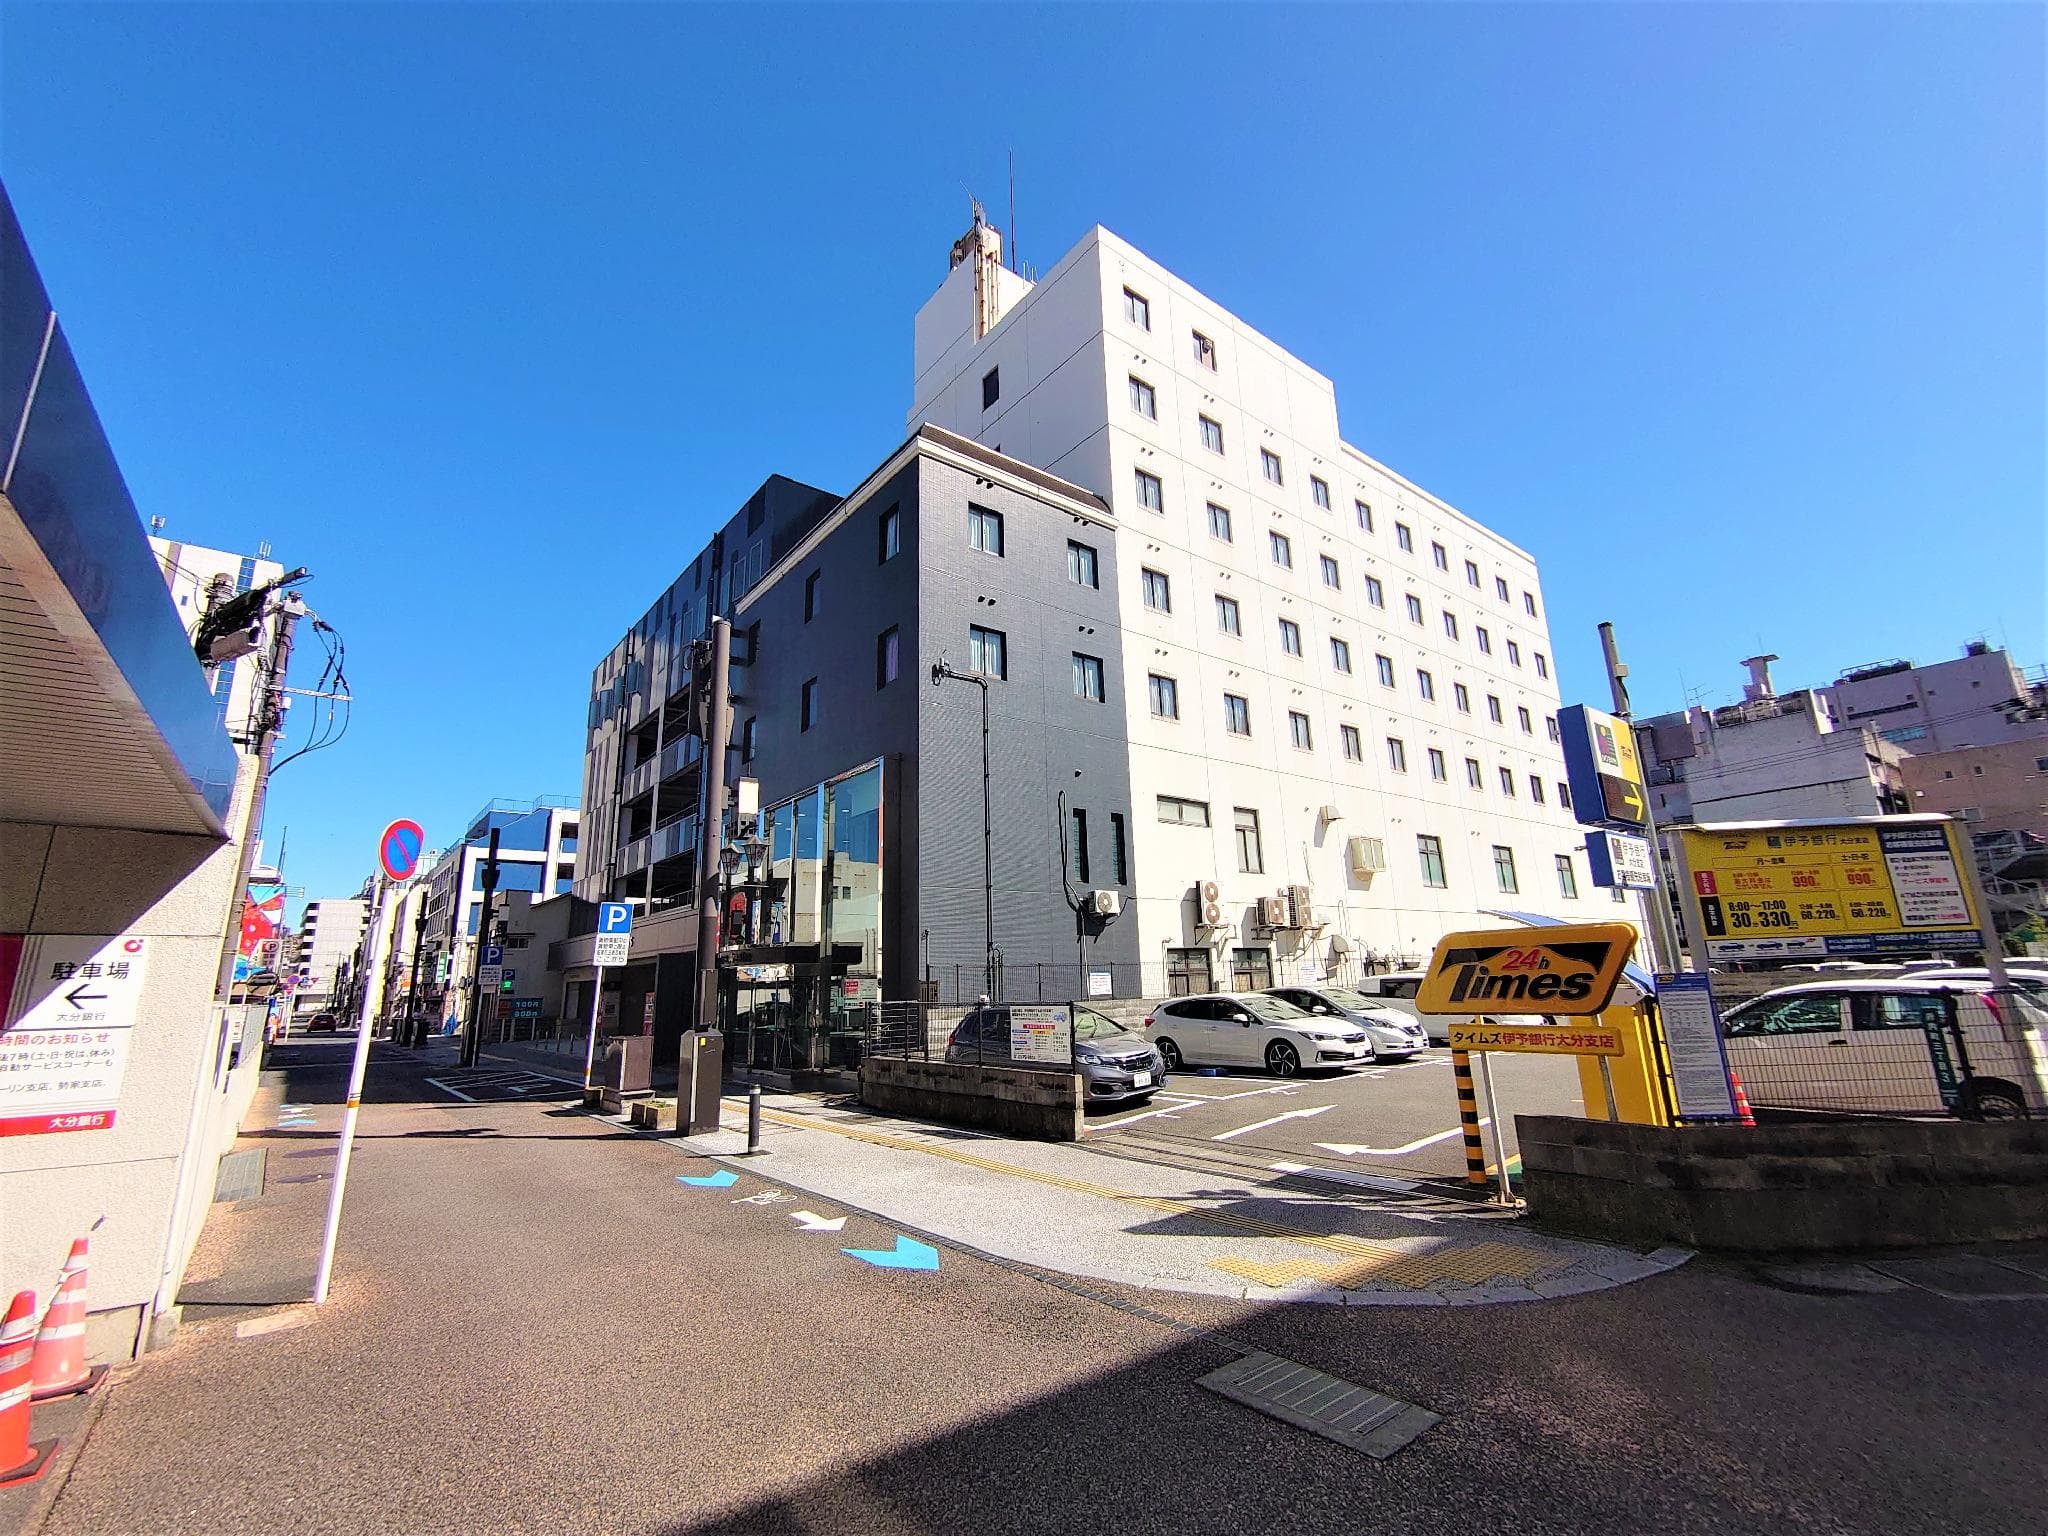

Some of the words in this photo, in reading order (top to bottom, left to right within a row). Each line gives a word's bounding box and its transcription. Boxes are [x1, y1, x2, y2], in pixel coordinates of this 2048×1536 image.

[607, 905, 627, 931] P
[487, 948, 500, 964] P
[50, 961, 130, 981] 駐車場
[1449, 964, 1596, 1003] Times
[56, 1012, 106, 1023] 大分銀行
[1453, 1031, 1615, 1049] タイムズ伊予銀行大分支店
[49, 1113, 106, 1129] 大分銀行
